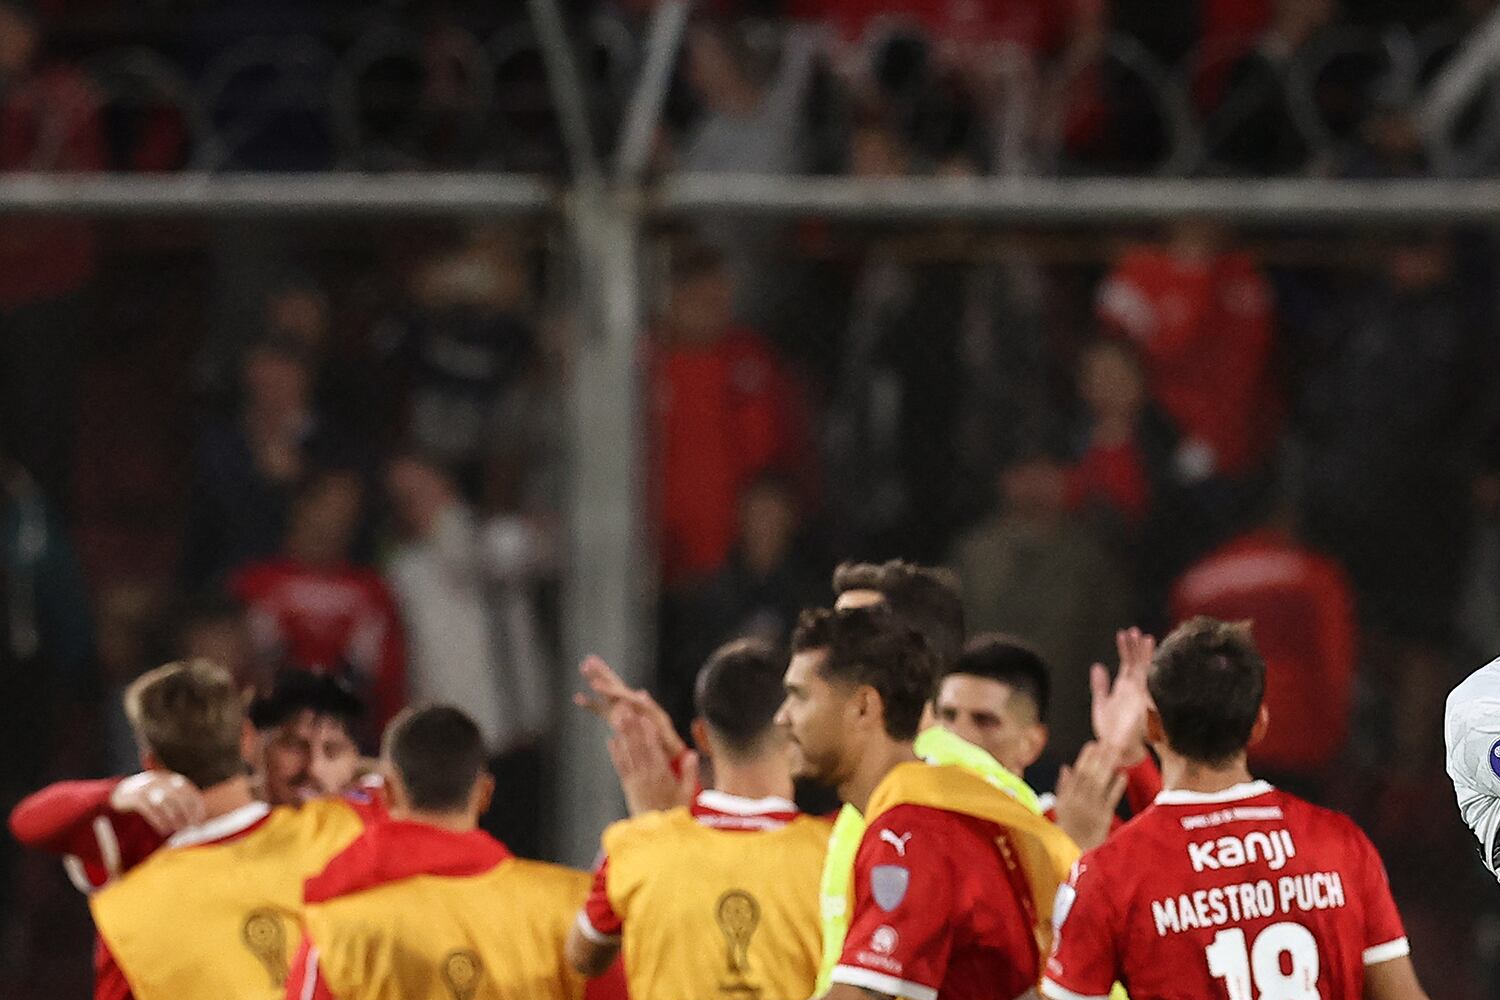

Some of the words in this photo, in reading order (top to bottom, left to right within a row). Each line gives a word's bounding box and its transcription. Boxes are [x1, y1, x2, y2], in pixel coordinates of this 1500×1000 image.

[1187, 829, 1296, 872] kanji
[1152, 880, 1275, 937] MAESTRO
[1278, 871, 1345, 913] PUCH
